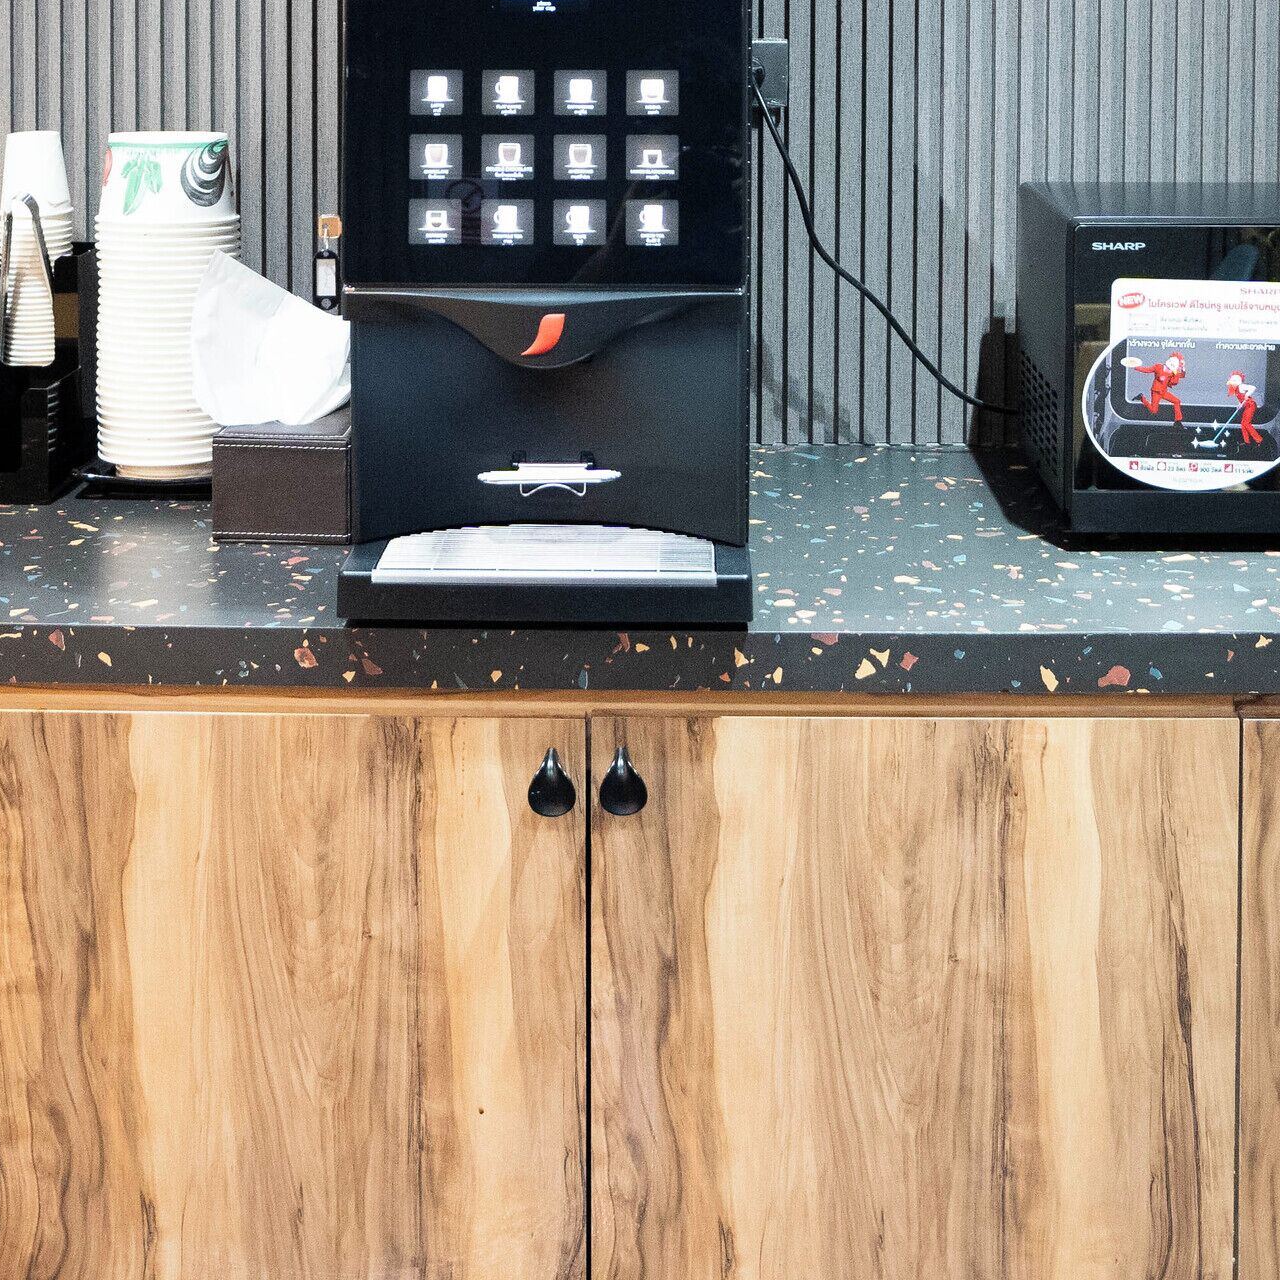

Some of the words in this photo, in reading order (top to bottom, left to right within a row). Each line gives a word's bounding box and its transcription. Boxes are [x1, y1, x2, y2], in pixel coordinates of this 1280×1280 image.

[1091, 242, 1146, 250] SHARP
[1121, 294, 1142, 307] NEW
[1148, 298, 1187, 309] ไมโครเวฟ
